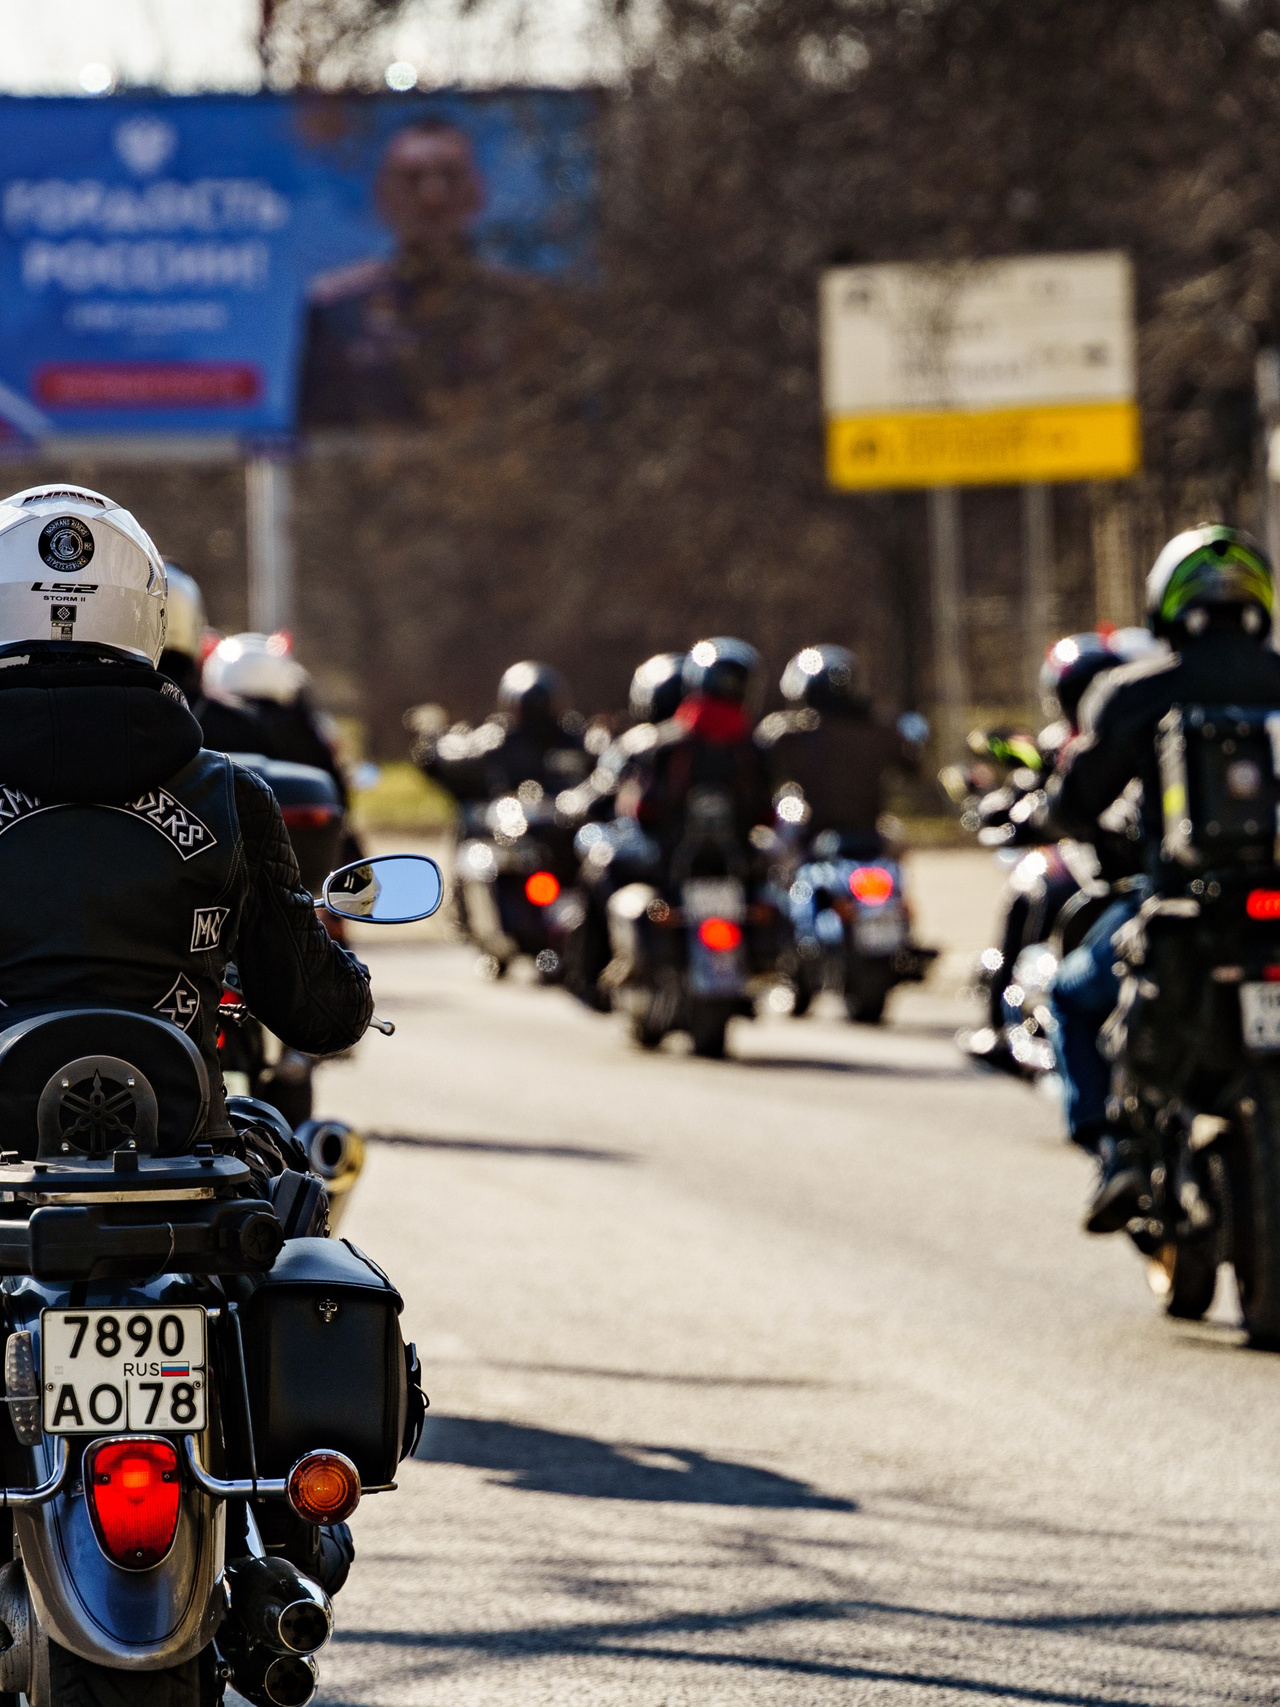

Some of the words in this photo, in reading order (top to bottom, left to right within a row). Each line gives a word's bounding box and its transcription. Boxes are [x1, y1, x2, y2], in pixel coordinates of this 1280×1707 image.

[31, 582, 99, 594] LS2
[124, 791, 204, 847] DERS
[195, 911, 221, 946] MC
[64, 1314, 185, 1358] 7890
[123, 1362, 160, 1377] RUS
[139, 1382, 197, 1425] 78
